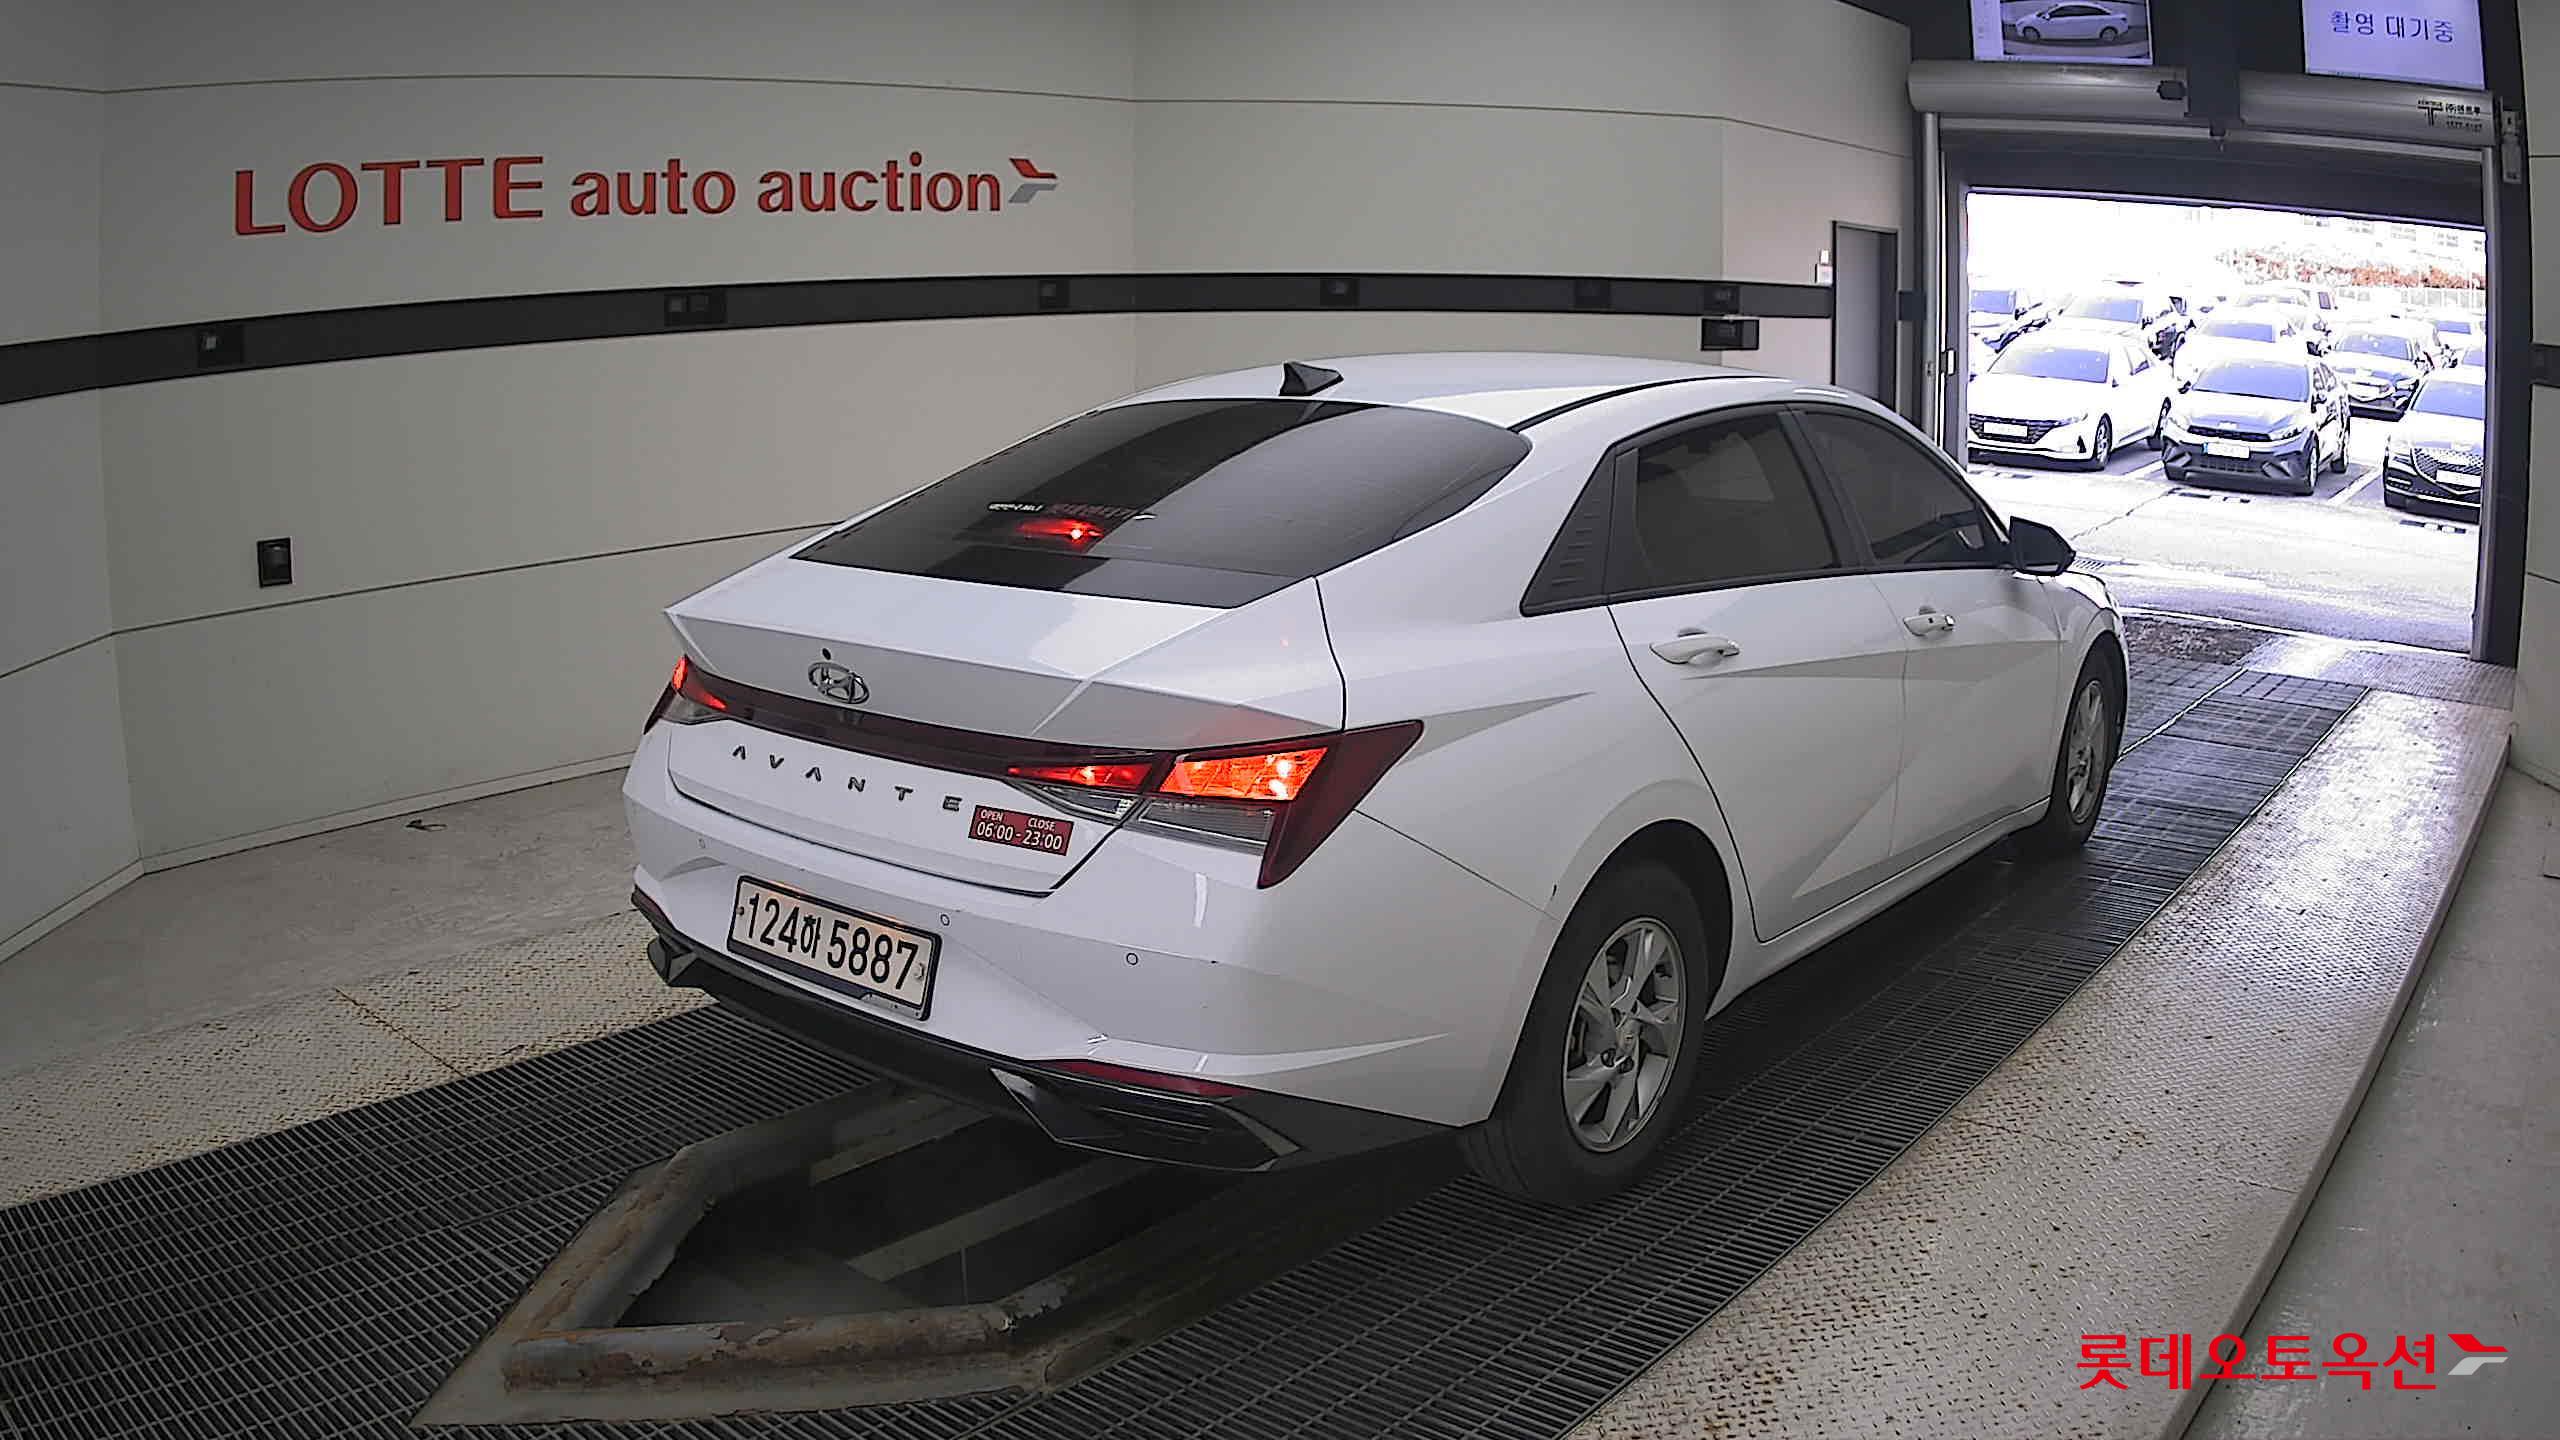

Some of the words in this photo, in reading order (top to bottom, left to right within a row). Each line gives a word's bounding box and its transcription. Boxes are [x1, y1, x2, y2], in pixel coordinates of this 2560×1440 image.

[2331, 10, 2375, 37] 촬영
[2385, 15, 2454, 44] 대기중
[234, 156, 544, 236] LOTTE
[570, 157, 736, 218] auto
[757, 152, 1001, 214] auction
[732, 745, 963, 812] AVANTE
[980, 809, 1004, 822] OPEN
[1027, 817, 1057, 832] CLOSE
[827, 919, 919, 990] 5887
